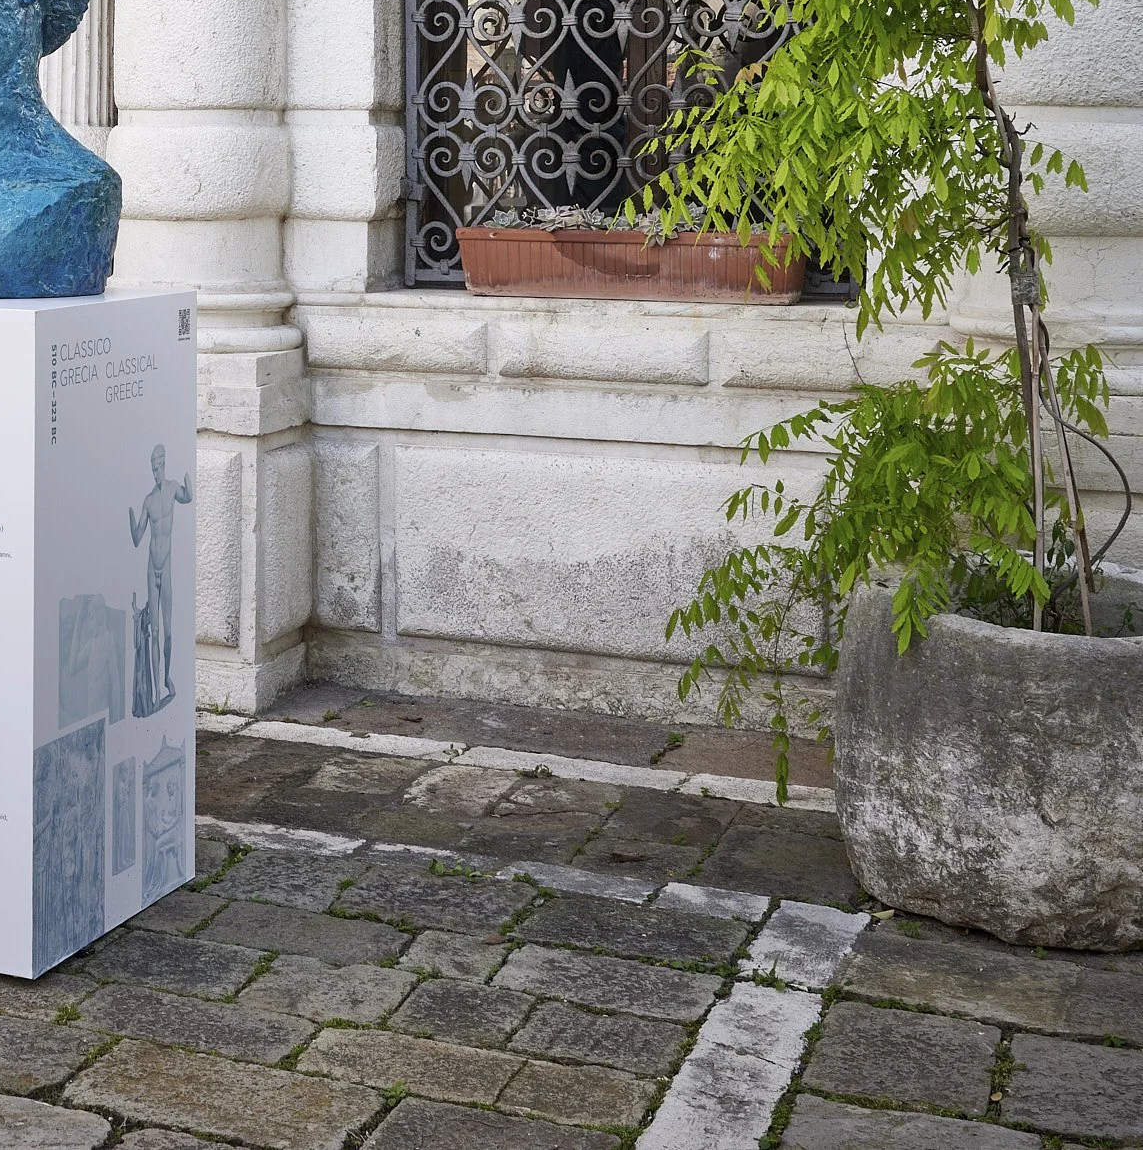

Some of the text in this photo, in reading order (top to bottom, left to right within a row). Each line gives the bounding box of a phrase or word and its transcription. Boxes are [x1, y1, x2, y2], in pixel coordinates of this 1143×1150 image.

[60, 338, 112, 361] CLASSICO
[60, 365, 99, 386] GRECIA
[105, 355, 158, 379] CLASSICAL
[51, 372, 57, 388] BC
[105, 380, 144, 403] GREECE
[51, 427, 57, 444] BC
